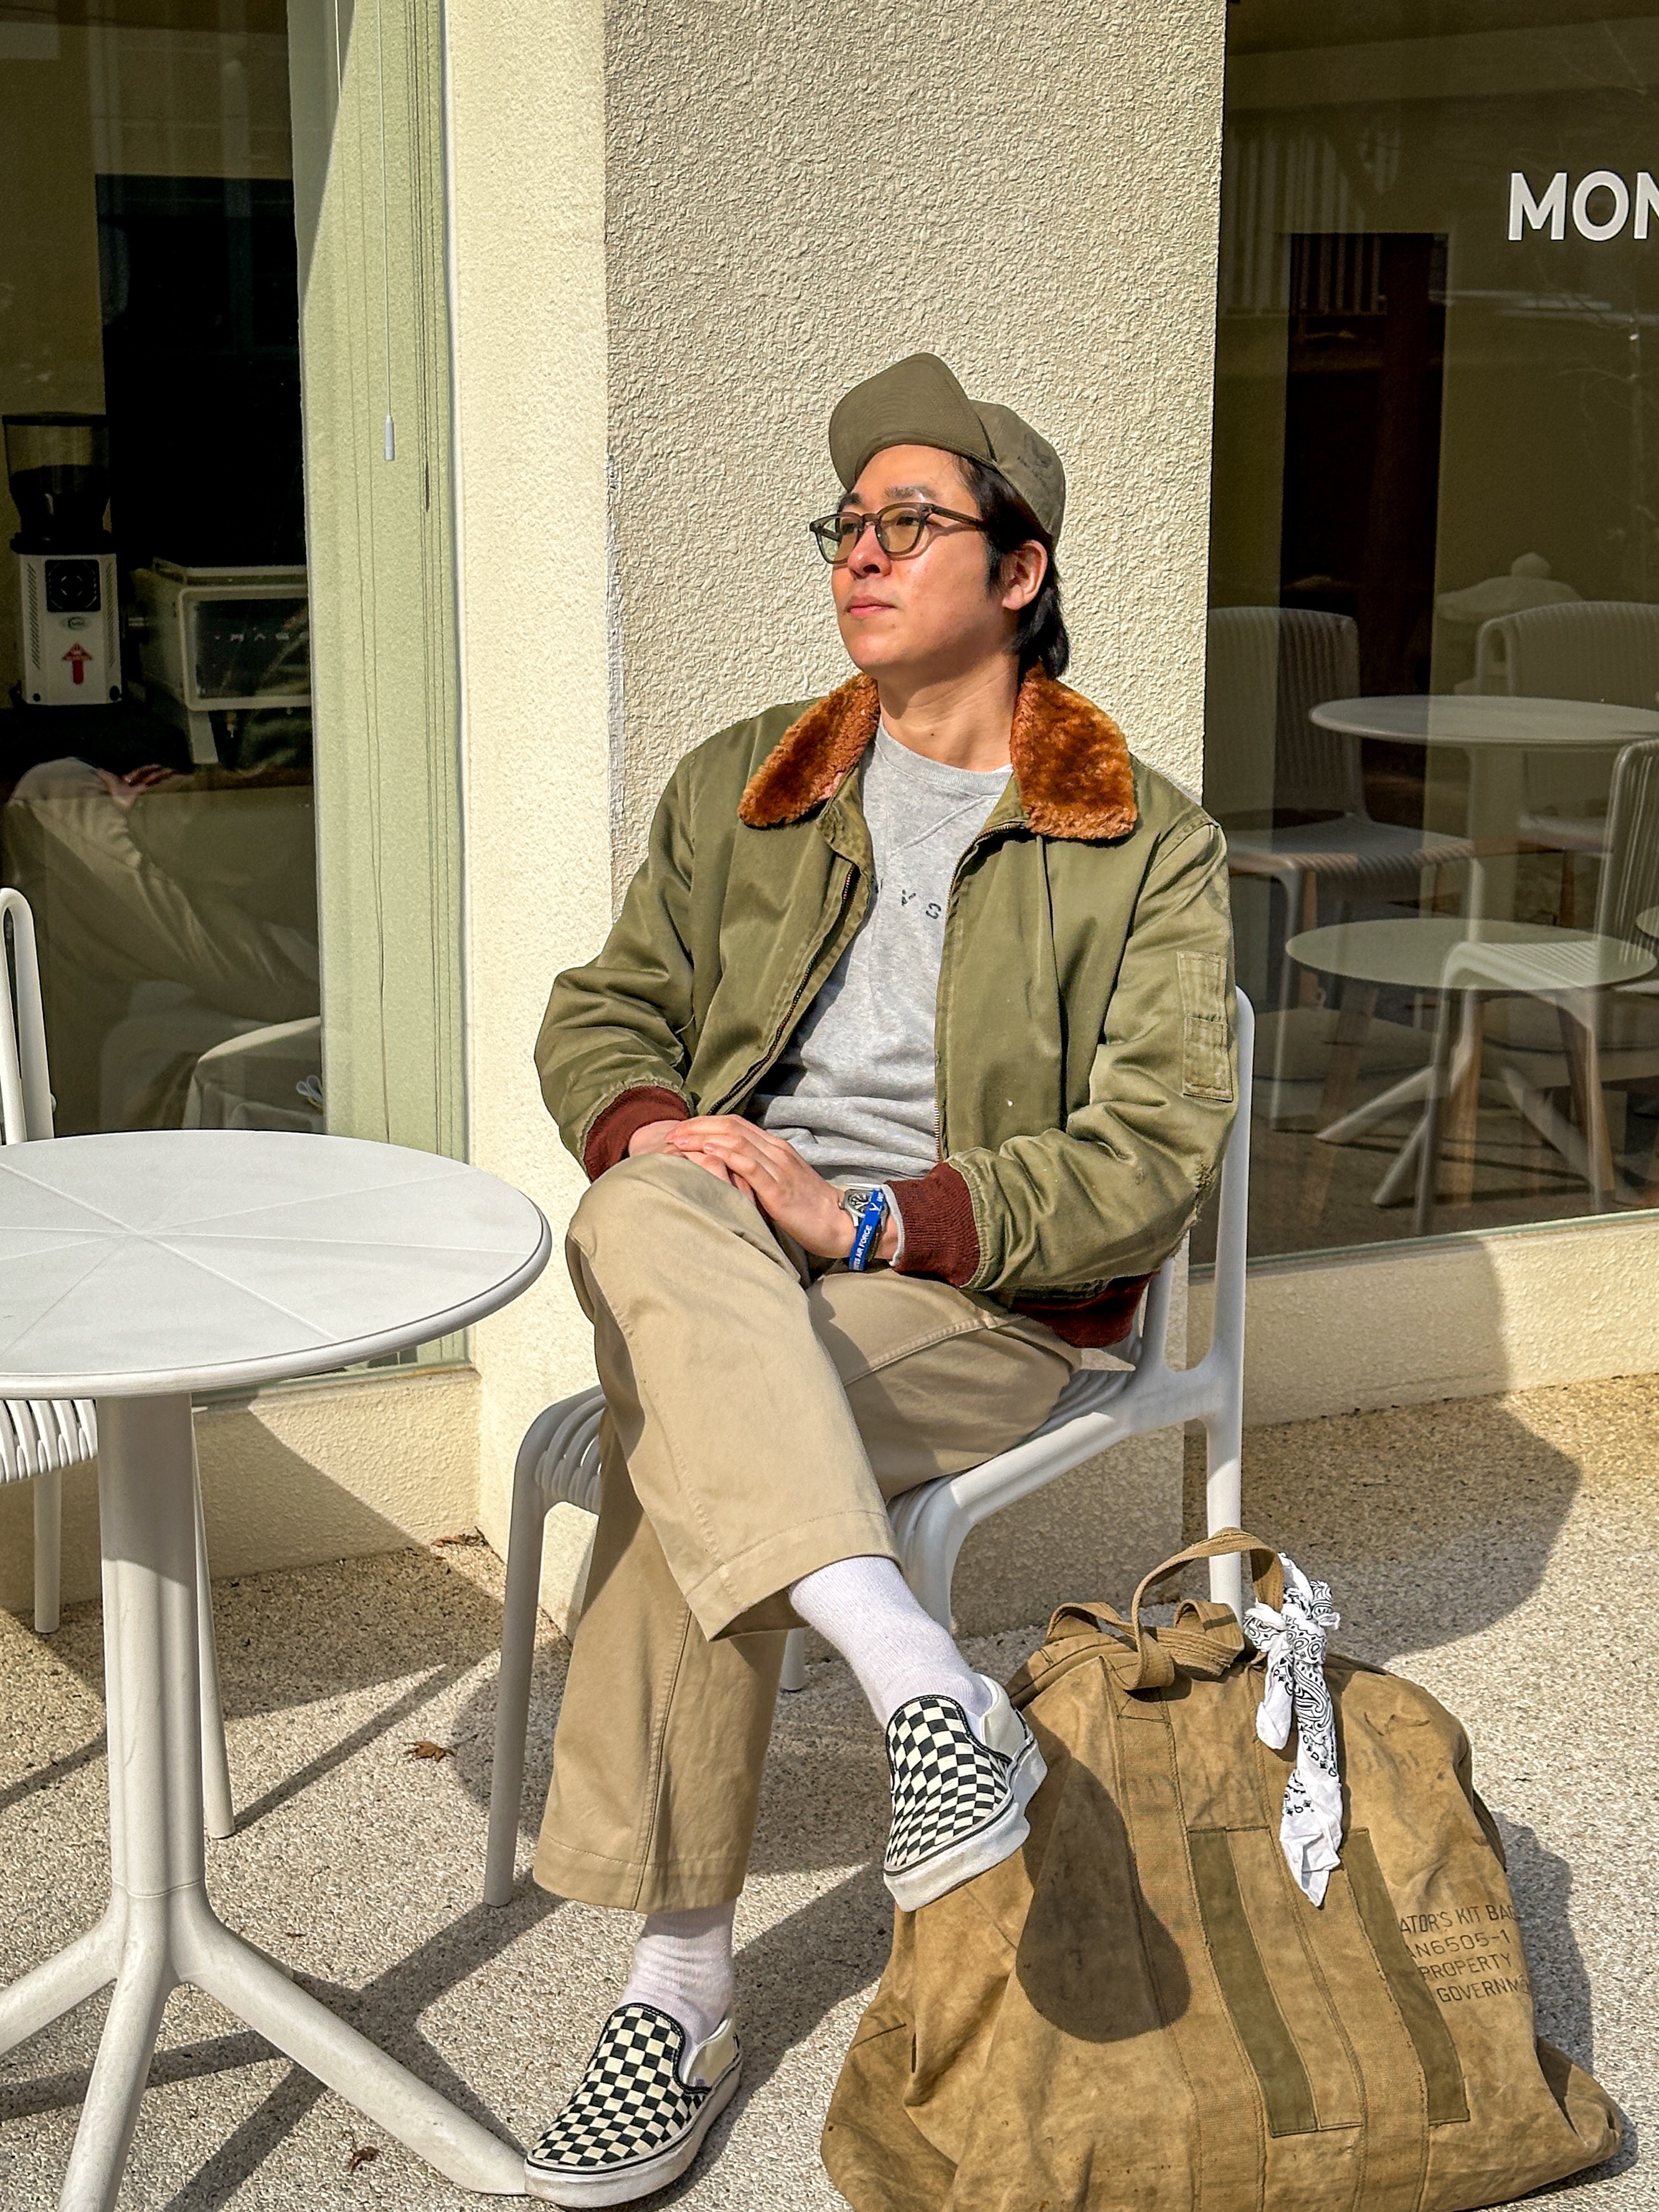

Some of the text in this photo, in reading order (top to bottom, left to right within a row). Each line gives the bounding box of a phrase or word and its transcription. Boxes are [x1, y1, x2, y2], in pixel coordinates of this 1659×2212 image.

[859, 1224, 872, 1249] FORCE
[855, 1247, 865, 1259] AIR
[1455, 1906, 1483, 1925] KIT
[1417, 1952, 1513, 1981] PROPERTY
